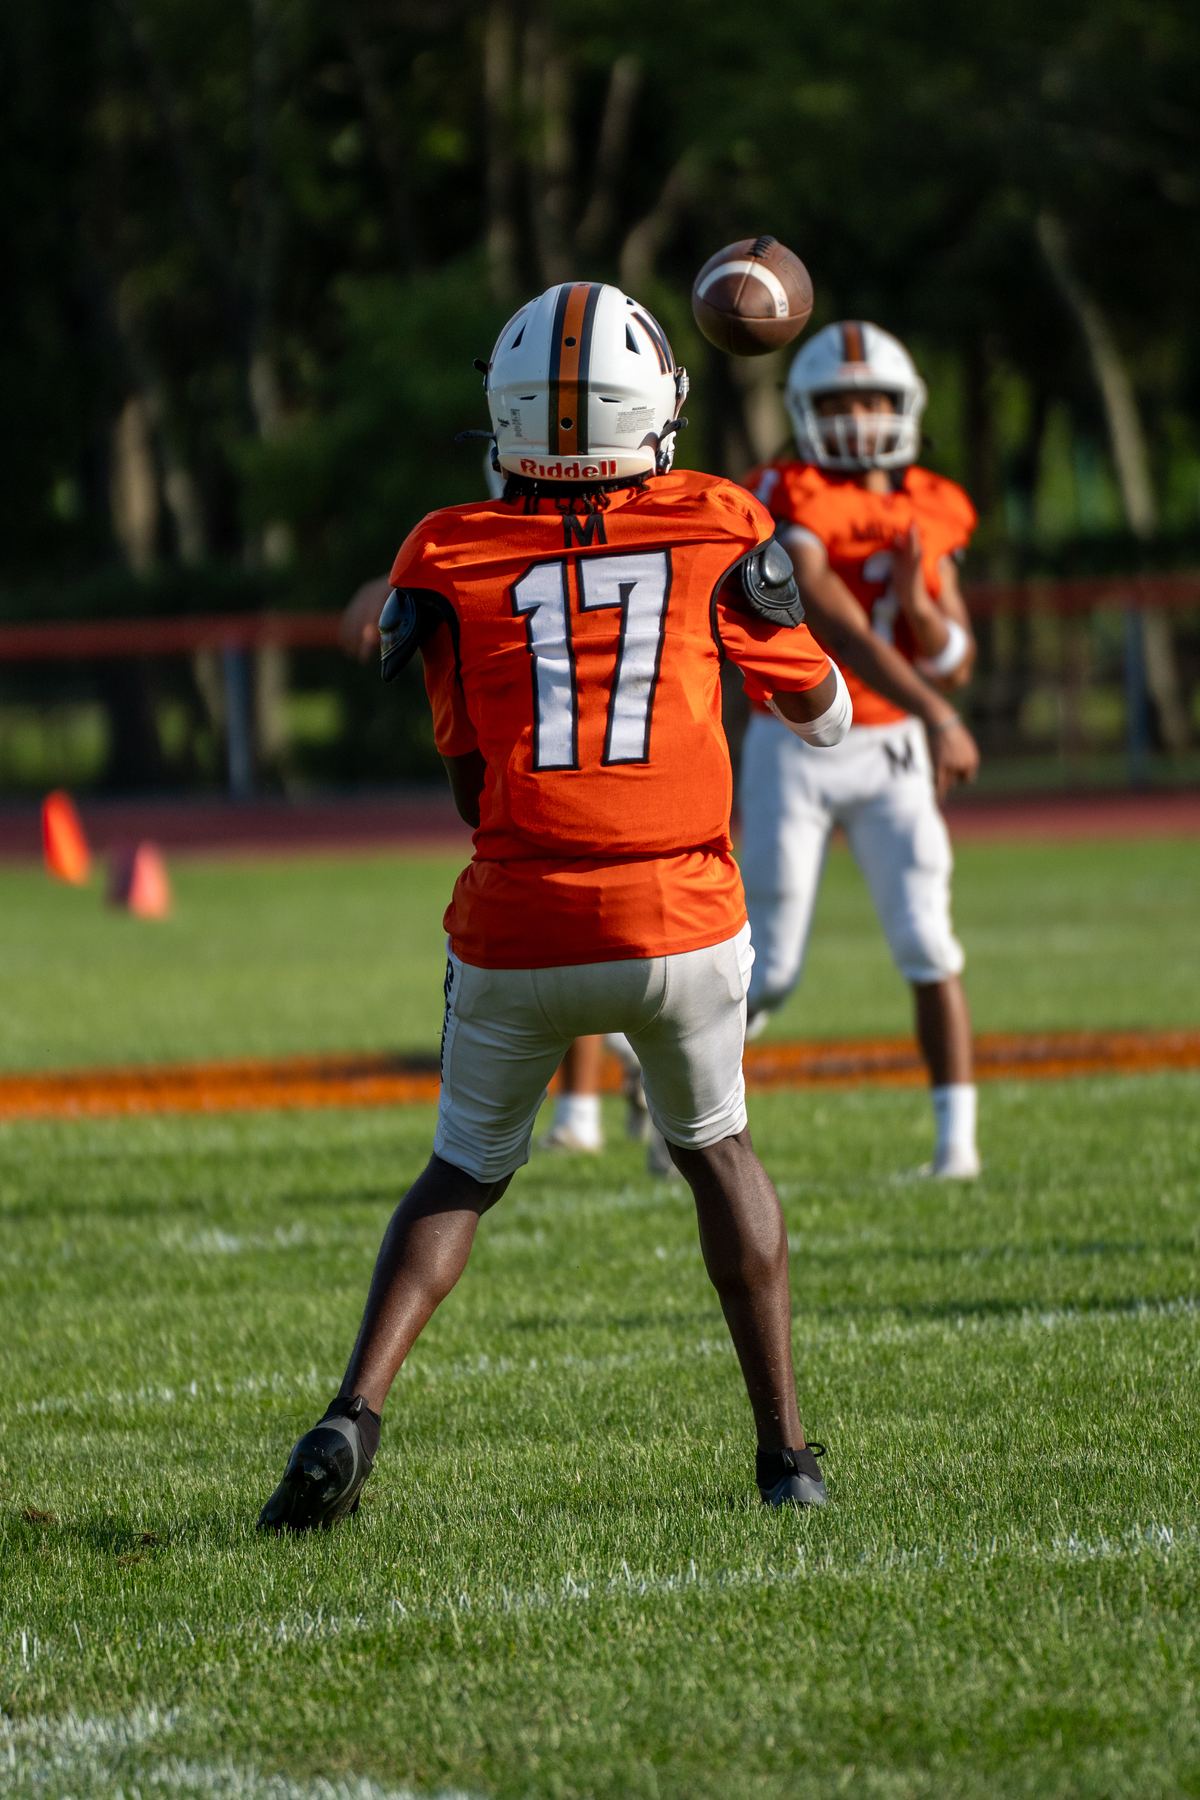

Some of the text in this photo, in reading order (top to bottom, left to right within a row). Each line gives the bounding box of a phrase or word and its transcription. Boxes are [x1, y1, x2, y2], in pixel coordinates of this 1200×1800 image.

[520, 458, 617, 479] Riddell
[562, 513, 608, 548] M
[509, 548, 672, 772] 17
[881, 734, 915, 779] M
